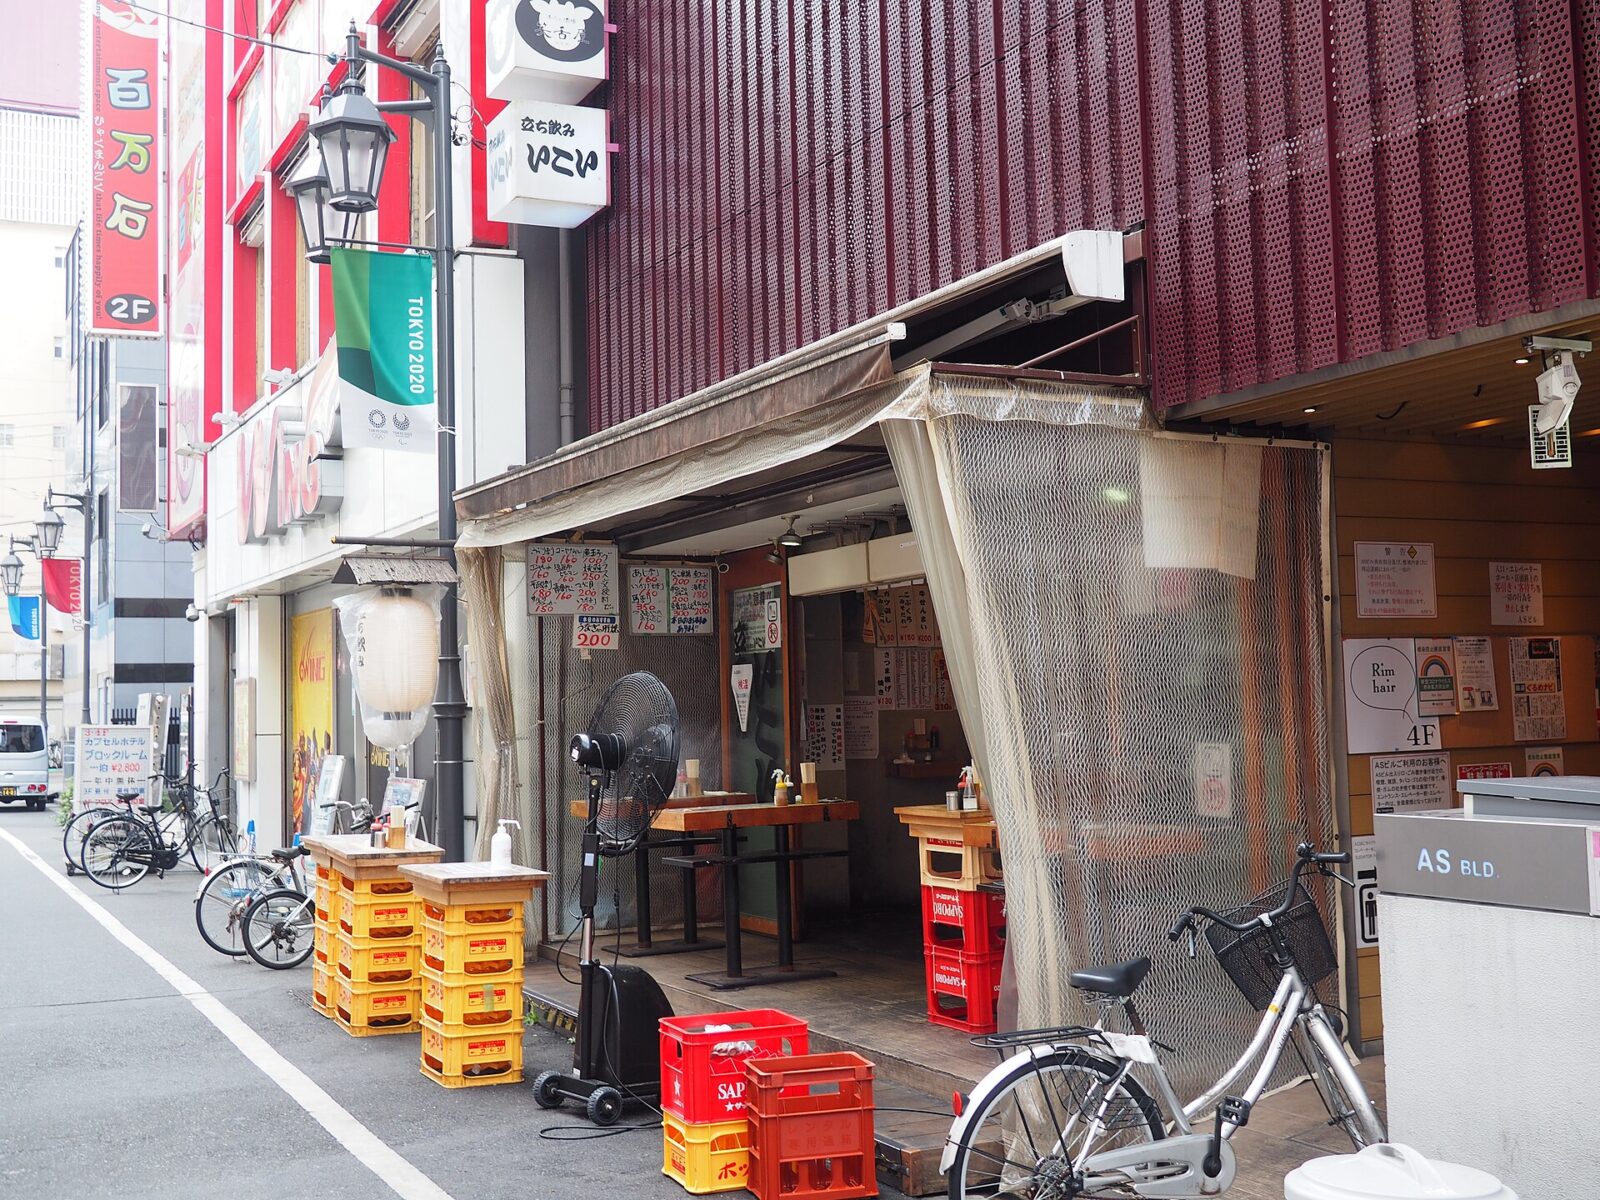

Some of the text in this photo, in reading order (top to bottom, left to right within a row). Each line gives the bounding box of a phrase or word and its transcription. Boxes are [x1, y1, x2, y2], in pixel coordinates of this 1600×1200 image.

[521, 116, 575, 138] 立ち飲み
[105, 67, 154, 240] 百万石
[526, 143, 599, 179] いこい
[111, 297, 151, 320] 2F
[408, 296, 425, 394] TOKYO 2020
[69, 561, 81, 600] TOKYO
[532, 571, 549, 579] 160
[533, 589, 551, 598] 180
[578, 589, 596, 597] 200
[638, 621, 655, 630] 160
[577, 633, 611, 646] 200
[1371, 662, 1395, 677] Rim
[1372, 679, 1396, 693] hair
[1526, 683, 1553, 691] ぐるめナビ
[1406, 724, 1436, 746] 4F
[85, 749, 148, 760] ブロックルーム
[1375, 757, 1446, 769] ASビルご利用のお客様へ
[1417, 848, 1500, 878] AS BLD.
[933, 902, 963, 918] SAPPORO
[936, 973, 961, 987] SAPPORO
[718, 1081, 746, 1100] SAP
[788, 1120, 851, 1134] レンタル
[718, 1162, 749, 1180] ホッ
